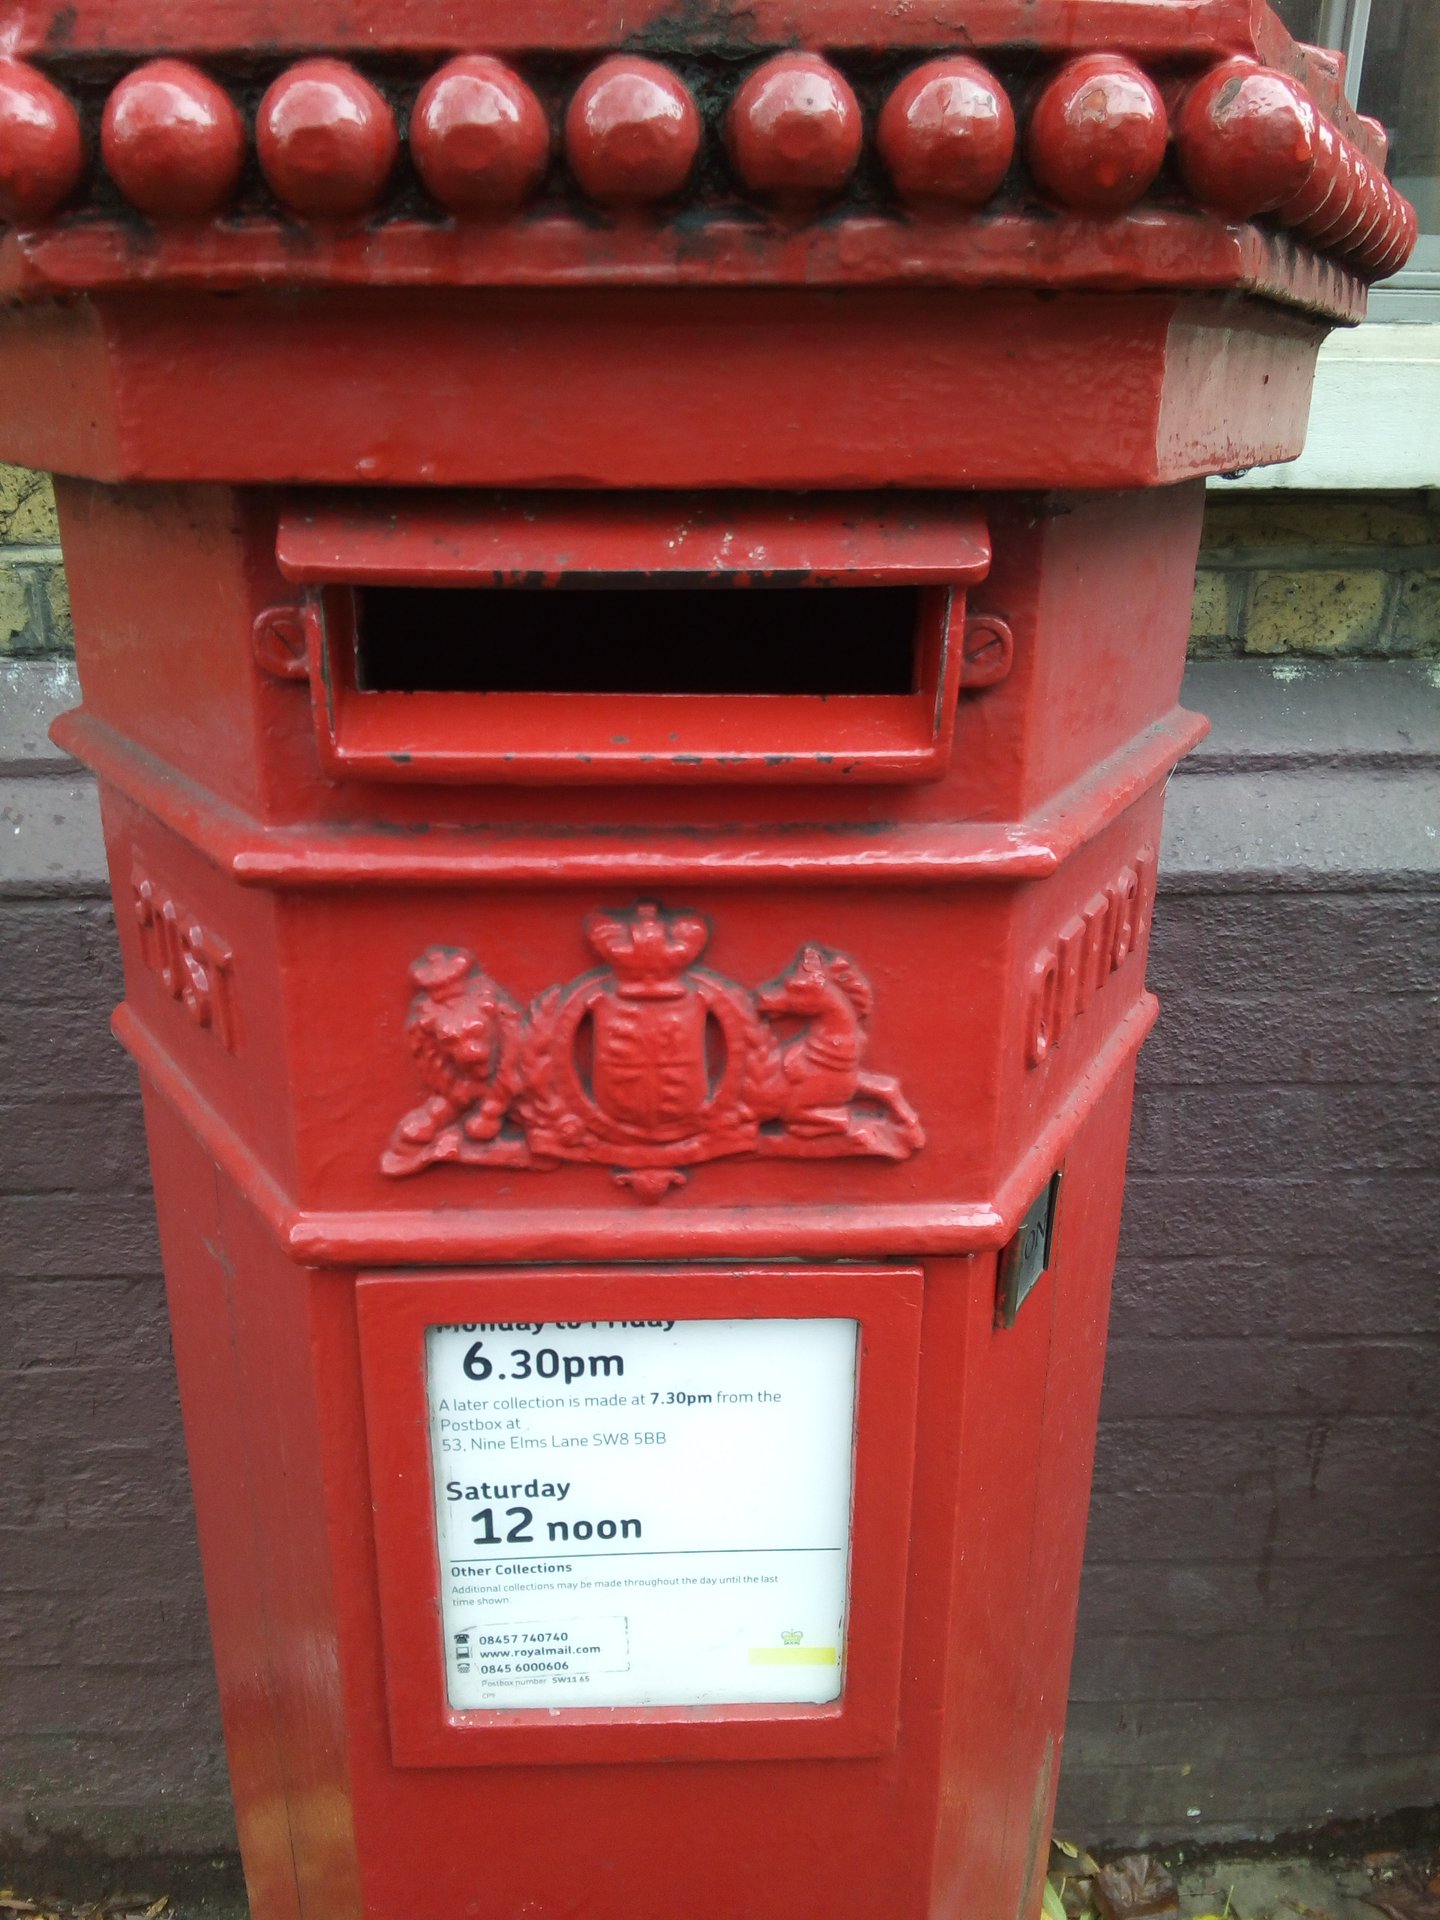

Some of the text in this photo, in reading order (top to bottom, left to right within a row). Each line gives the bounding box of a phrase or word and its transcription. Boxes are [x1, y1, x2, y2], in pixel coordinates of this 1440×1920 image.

[463, 1341, 625, 1383] 6.30pm
[438, 1389, 782, 1412] A later collection is made at 7.30pm from the
[441, 1418, 521, 1432] Postbox at
[470, 1435, 506, 1451] Nine
[510, 1435, 548, 1449] Elms
[552, 1433, 588, 1448] Lane
[592, 1433, 629, 1446] SW8
[634, 1432, 666, 1445] 5BB
[446, 1478, 570, 1501] Saturday
[471, 1507, 641, 1544] 12 noon
[451, 1563, 572, 1577] Other Collections
[452, 1585, 501, 1594] Additional
[503, 1582, 554, 1592] collections
[556, 1581, 577, 1590] may
[580, 1578, 592, 1588] be
[594, 1578, 622, 1588] made
[624, 1578, 679, 1587] throughout
[700, 1576, 717, 1585] day
[719, 1576, 741, 1584] until
[743, 1575, 759, 1583] the
[760, 1575, 778, 1583] last
[453, 1598, 475, 1606] time
[479, 1632, 569, 1645] 08457 740740
[480, 1645, 601, 1658] www.royalmail.com
[481, 1662, 569, 1674] 0845 6000606
[515, 1678, 547, 1687] number
